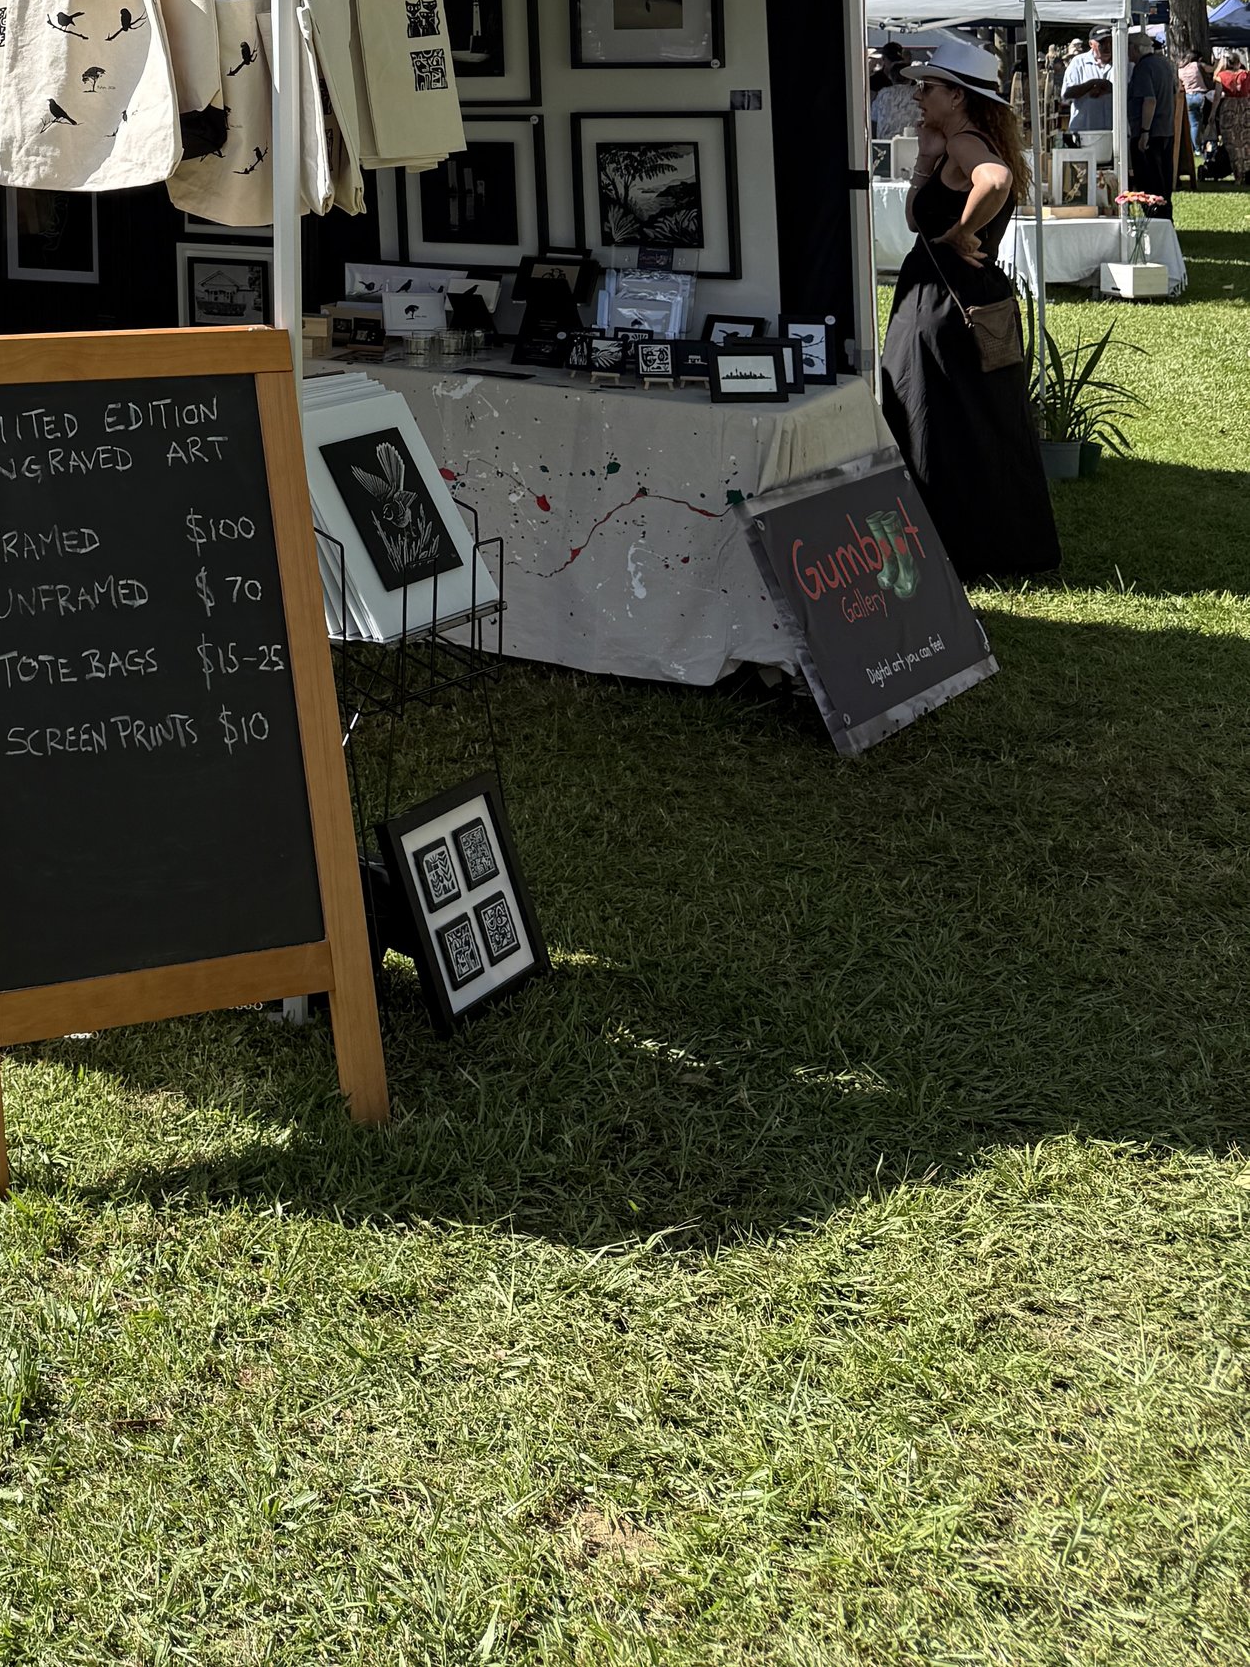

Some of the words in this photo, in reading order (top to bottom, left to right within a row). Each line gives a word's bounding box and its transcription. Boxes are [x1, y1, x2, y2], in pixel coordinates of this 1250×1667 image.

[104, 397, 218, 432] EDITION
[166, 436, 229, 466] ART
[186, 508, 255, 556] $100
[841, 588, 888, 623] Gallery
[81, 647, 158, 680] BAGS
[196, 633, 285, 691] $15-25
[865, 658, 893, 688] Digital
[892, 652, 906, 672] art
[905, 652, 921, 672] you
[919, 646, 933, 659] can
[928, 633, 946, 653] feel
[5, 721, 108, 755] SCREEN
[110, 713, 198, 751] PRINTS
[219, 704, 270, 755] $10
